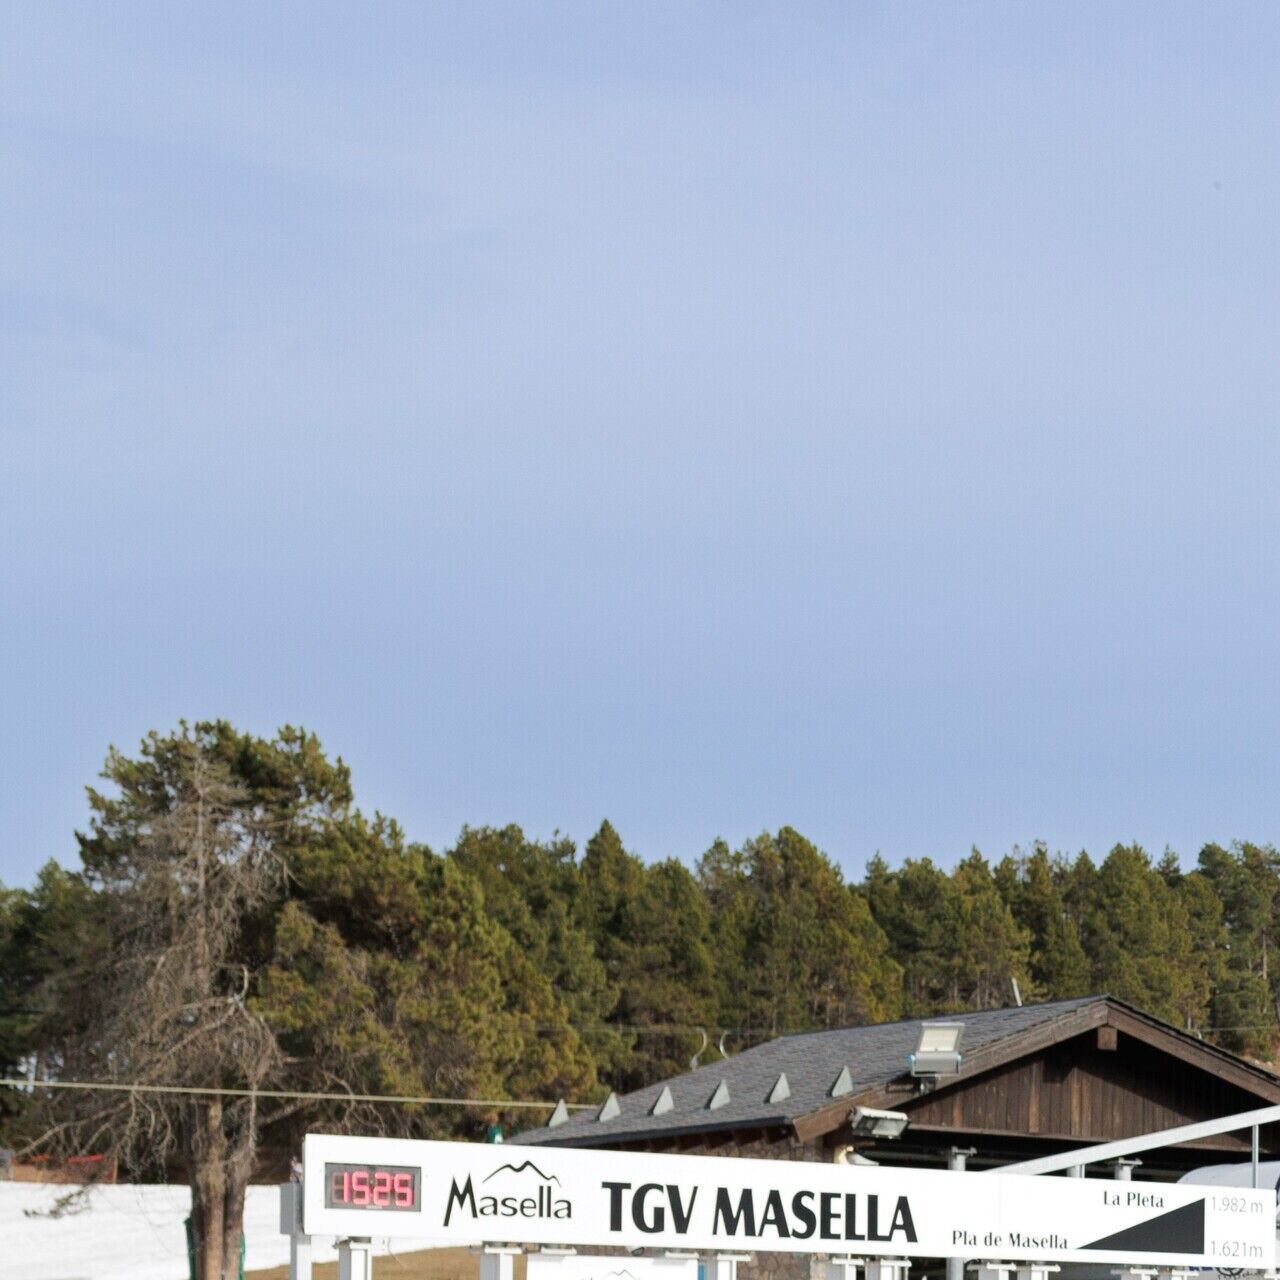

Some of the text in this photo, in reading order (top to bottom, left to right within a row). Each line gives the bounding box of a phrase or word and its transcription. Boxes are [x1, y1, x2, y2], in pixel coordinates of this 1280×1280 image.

[443, 1173, 572, 1227] Masella
[1103, 1190, 1164, 1208] La Pleta
[1212, 1196, 1264, 1213] 1.982 m
[601, 1181, 918, 1243] TGV MASELLA
[952, 1230, 1068, 1250] Pla de Masella
